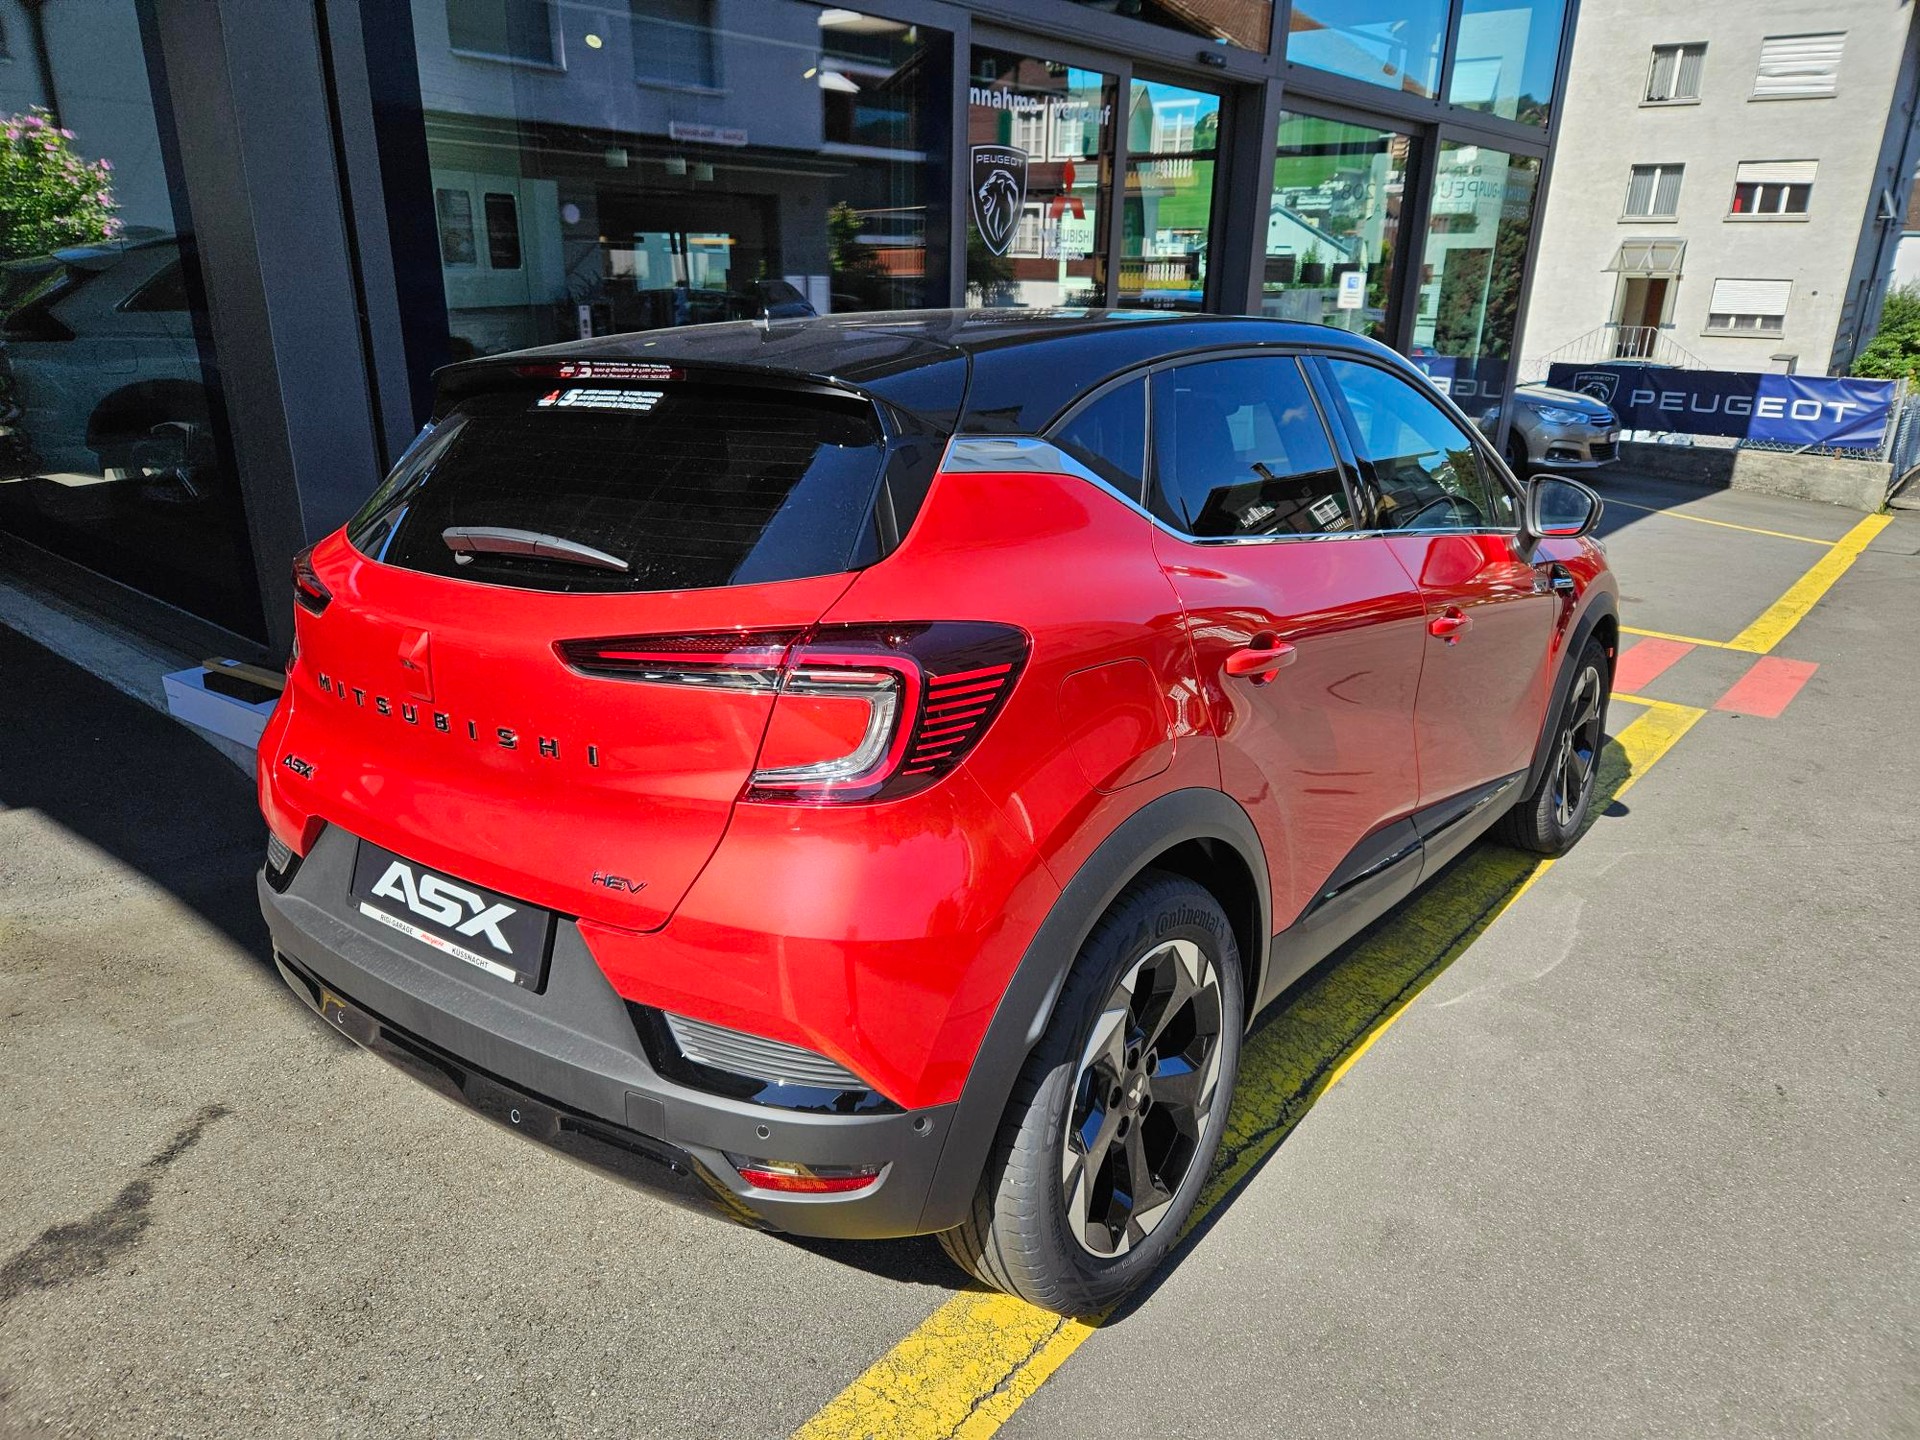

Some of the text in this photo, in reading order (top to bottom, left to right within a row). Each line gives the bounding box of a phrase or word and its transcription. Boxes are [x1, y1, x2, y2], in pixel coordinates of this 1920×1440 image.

[976, 154, 1024, 167] PEUGEOT
[1578, 374, 1616, 382] PEUGEOT
[1630, 389, 1857, 423] PEUGEOT
[318, 672, 600, 767] MITSUBISHI
[282, 753, 316, 780] ASX
[592, 870, 648, 895] HEV
[371, 861, 517, 954] ASX
[1155, 904, 1220, 939] Continental
